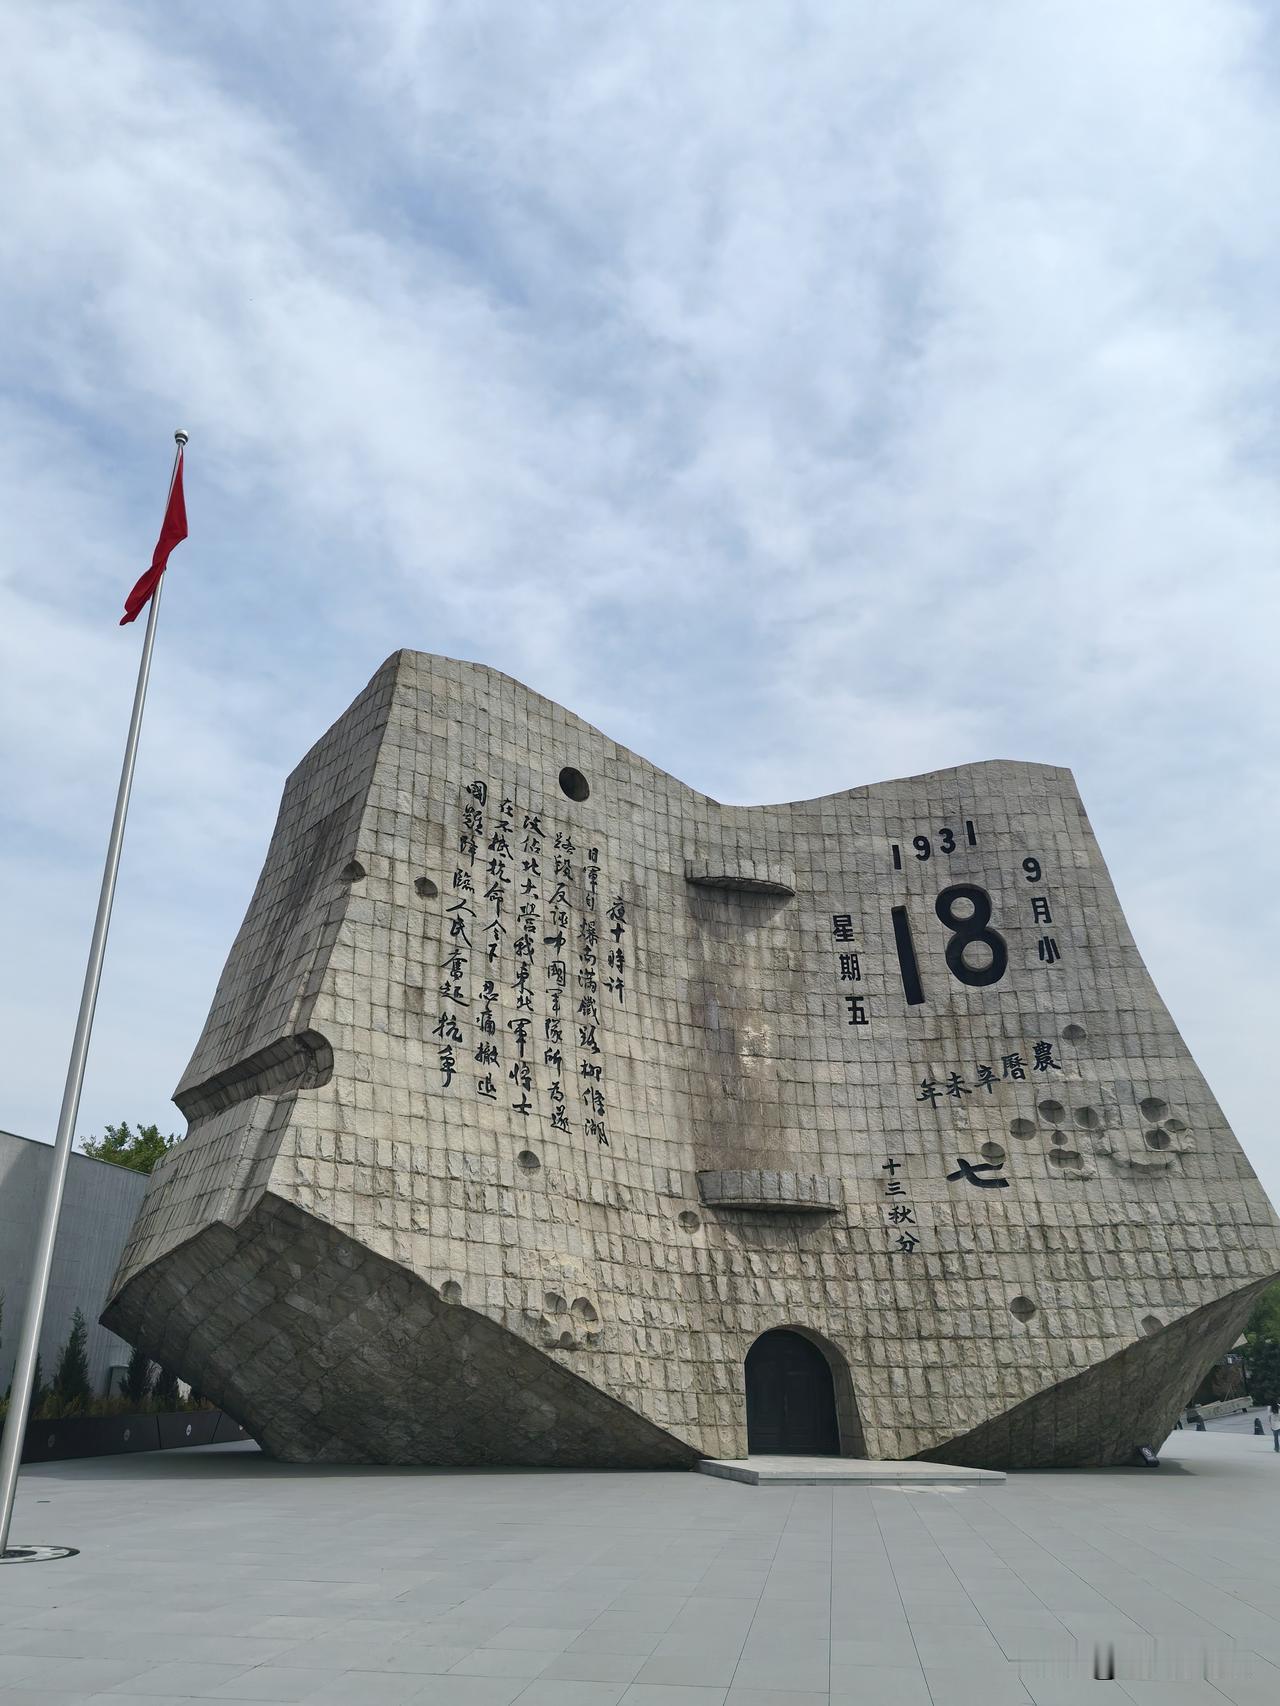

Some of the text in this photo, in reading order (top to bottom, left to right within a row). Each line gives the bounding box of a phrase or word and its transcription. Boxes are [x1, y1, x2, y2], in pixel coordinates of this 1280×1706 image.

[892, 820, 977, 870] 1931
[832, 914, 869, 1026] 星期五
[891, 882, 1009, 1006] 18
[946, 1158, 1010, 1189] 七
